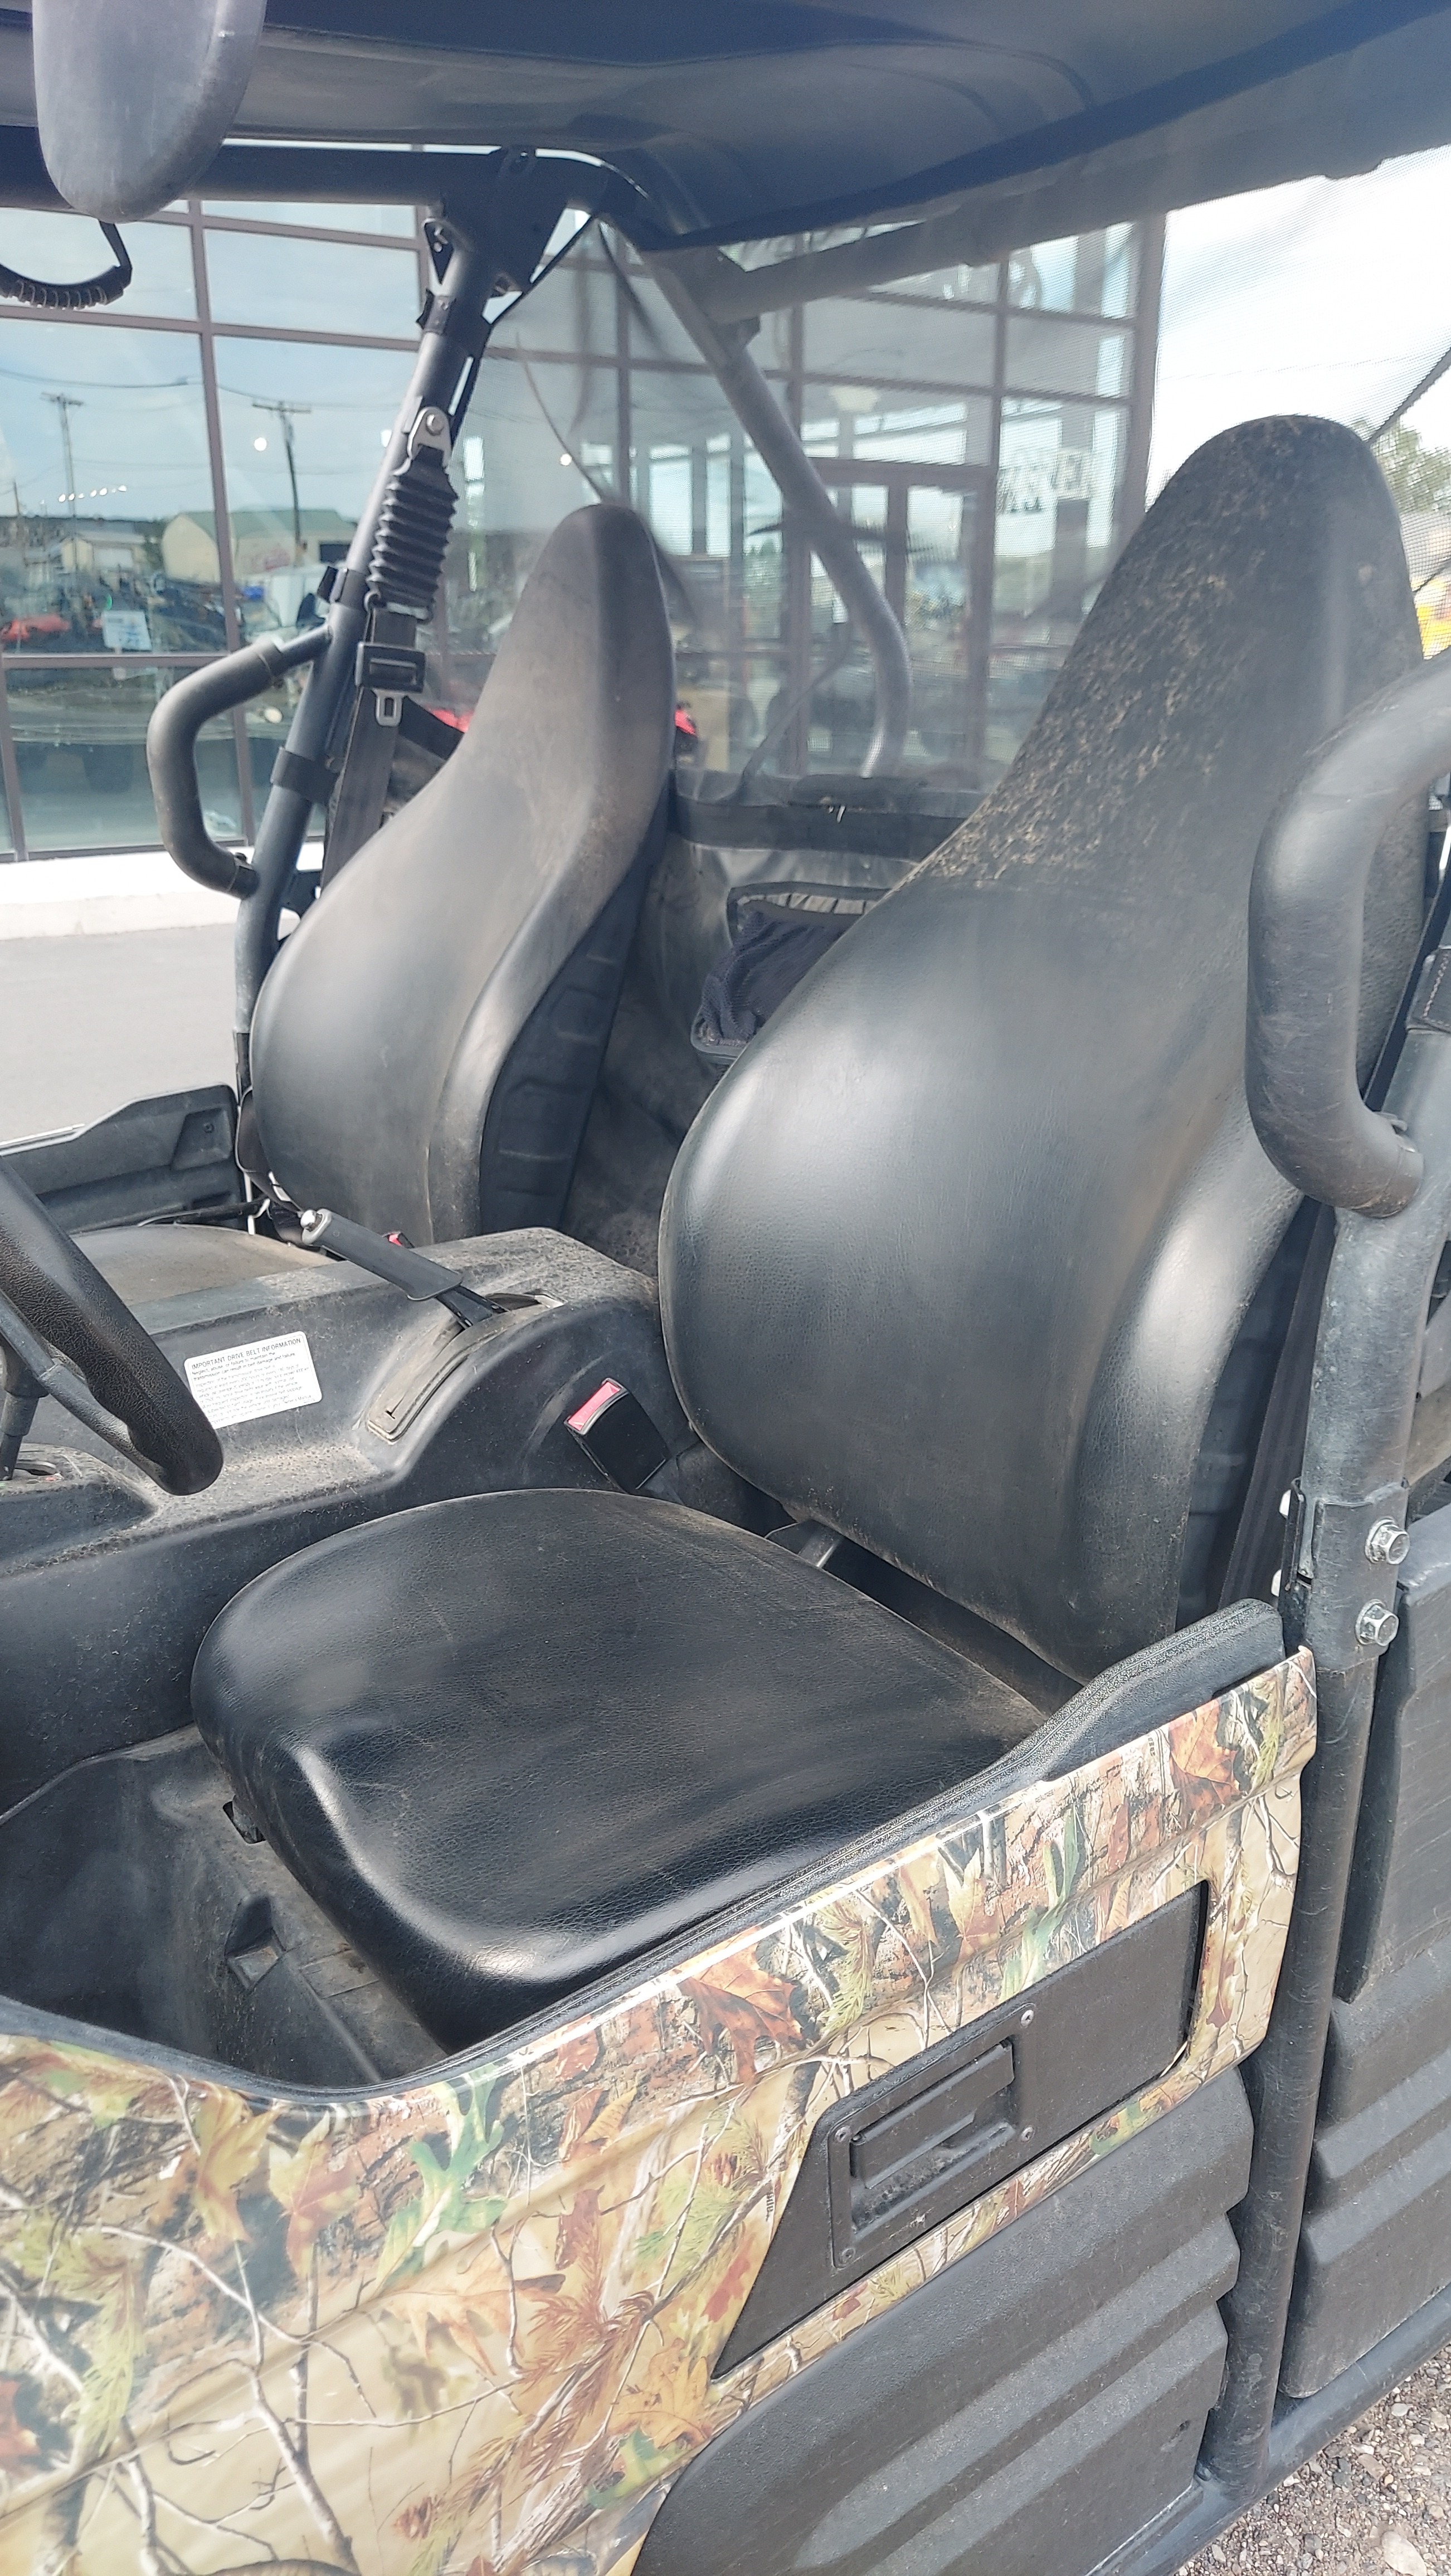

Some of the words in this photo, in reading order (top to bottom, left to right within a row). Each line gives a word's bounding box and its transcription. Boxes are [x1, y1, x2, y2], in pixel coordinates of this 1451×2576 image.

[191, 1357, 225, 1370] IMPORTANT
[227, 1352, 245, 1361] DRIVE
[246, 1348, 260, 1357] BELT
[261, 1338, 301, 1352] INFORMATION
[193, 1372, 220, 1381] transmission
